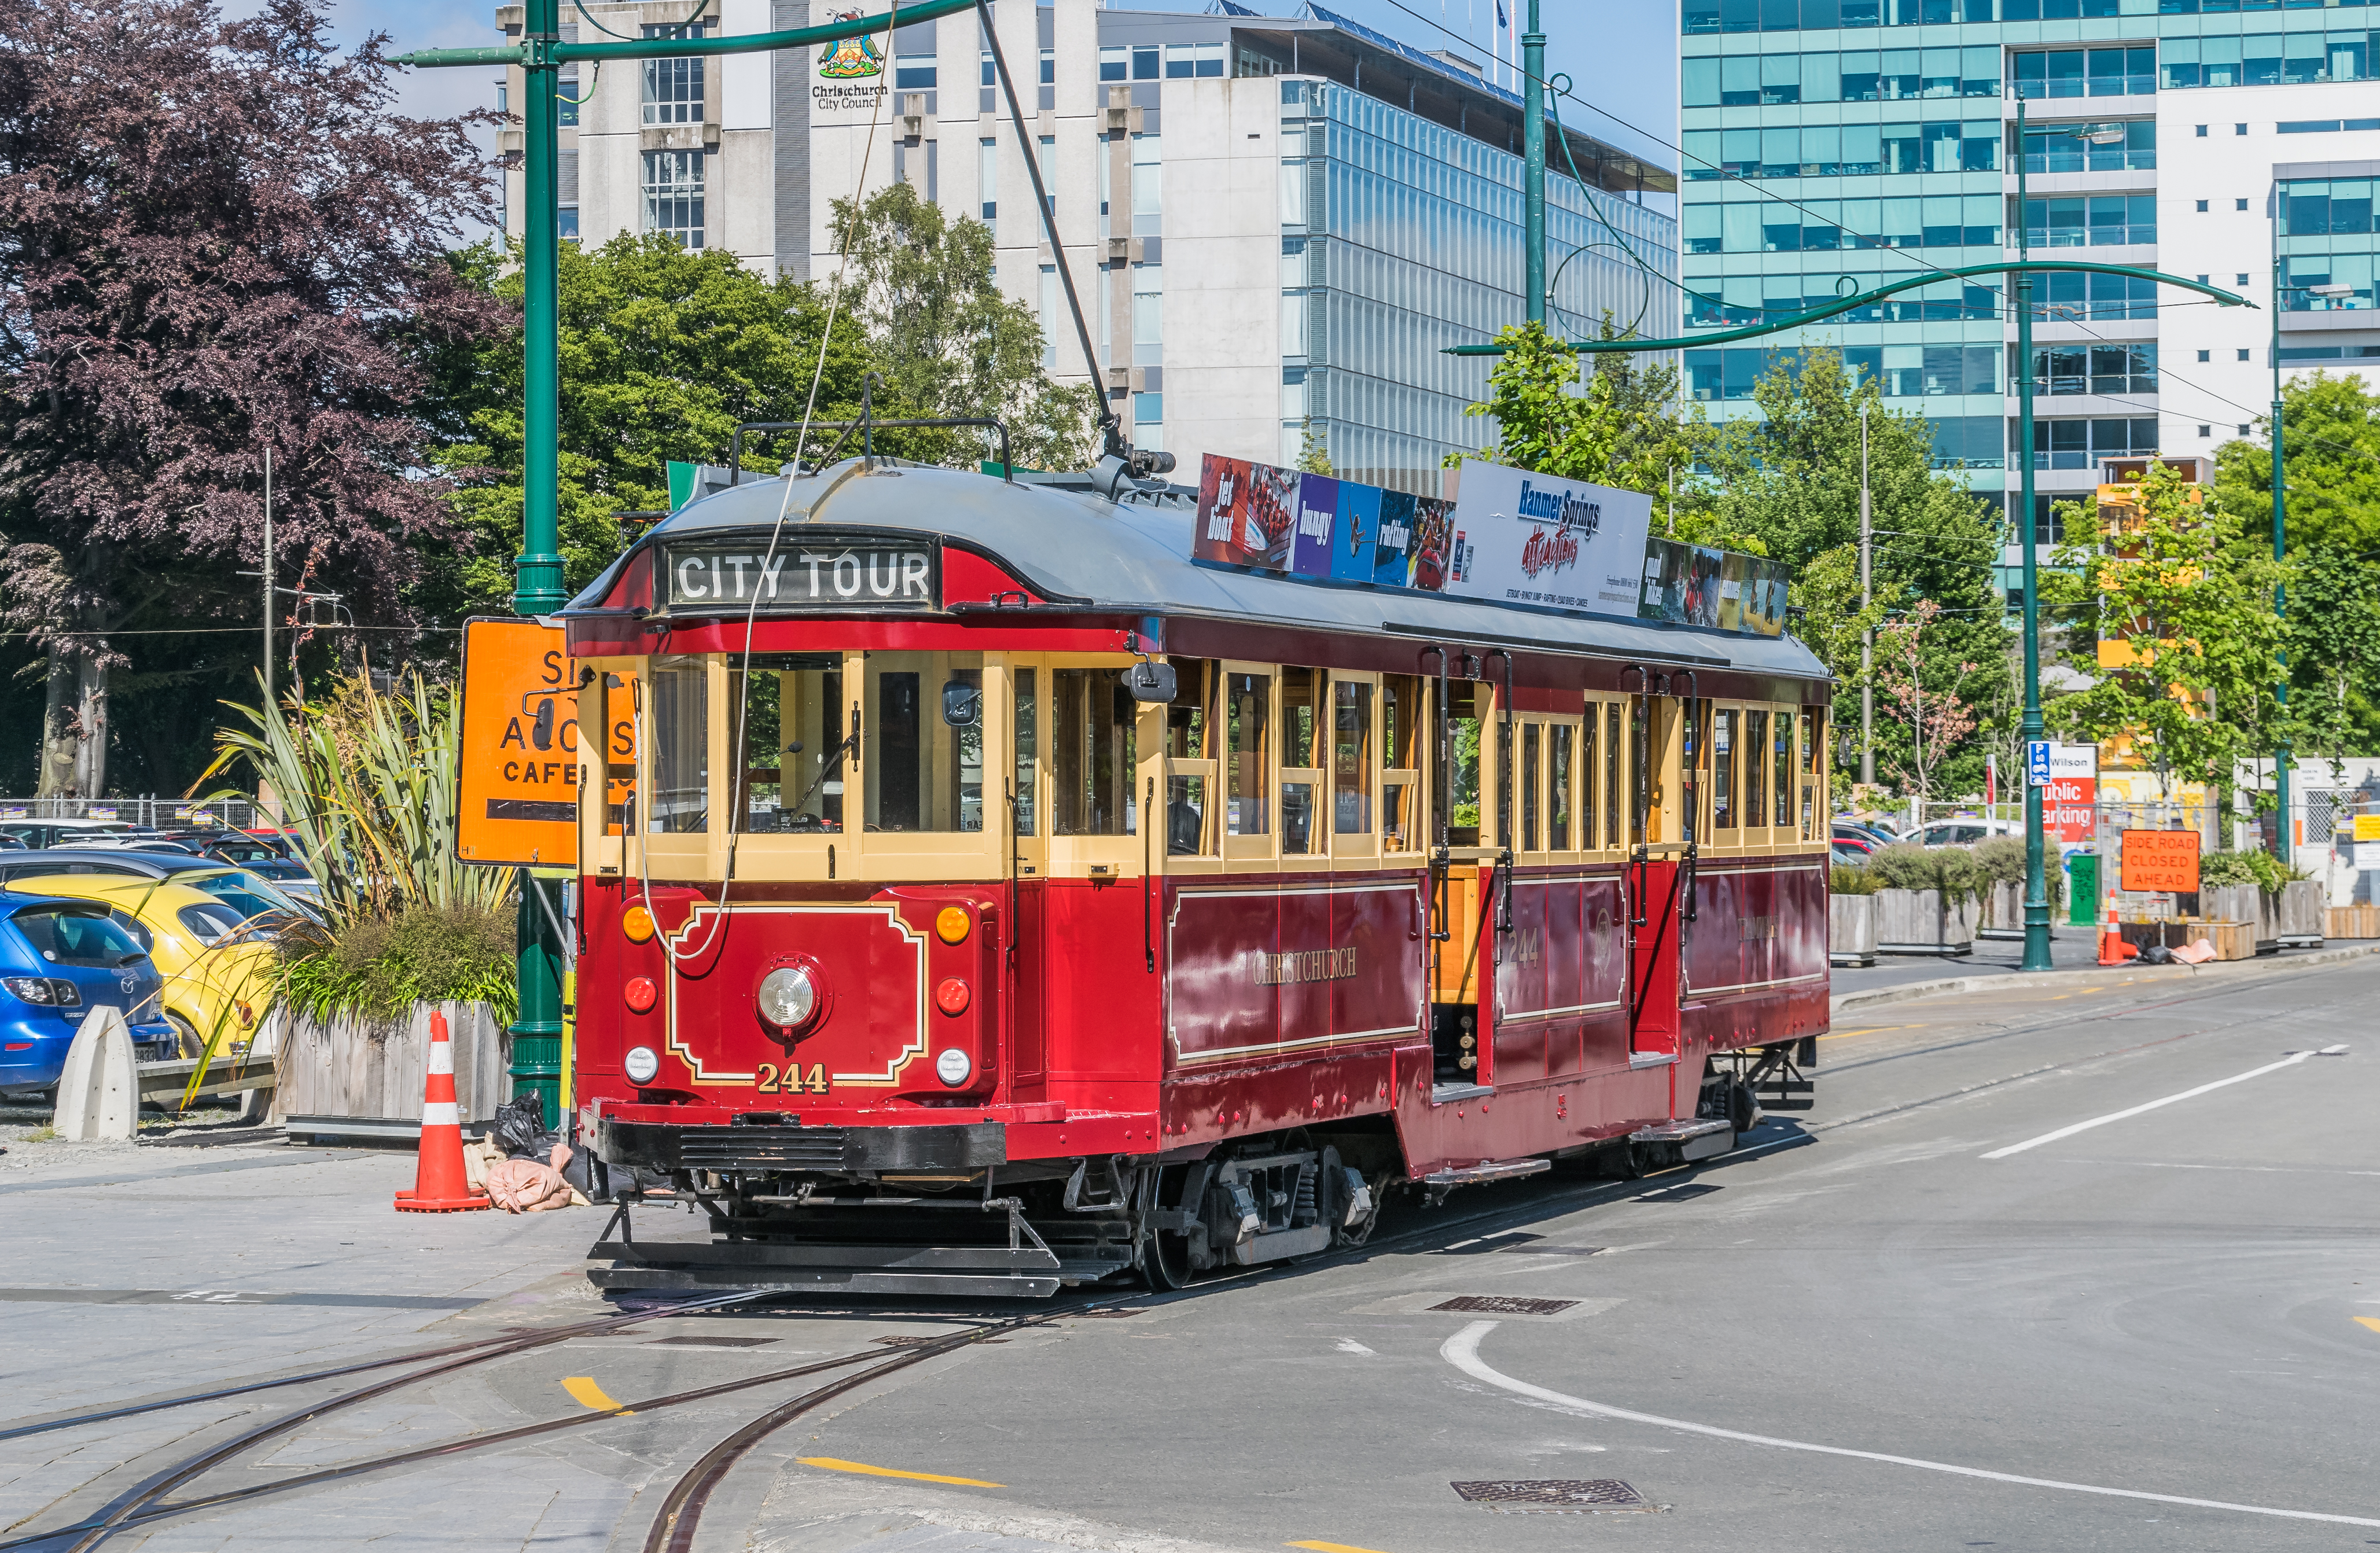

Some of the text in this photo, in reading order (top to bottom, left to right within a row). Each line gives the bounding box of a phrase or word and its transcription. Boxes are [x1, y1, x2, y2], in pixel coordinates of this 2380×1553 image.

[812, 84, 888, 97] Christchurch
[818, 99, 839, 112] City
[1215, 472, 1234, 511] jet
[1518, 480, 1600, 536] Hanmer Springs
[1208, 507, 1234, 542] boat
[1299, 501, 1332, 546] bungy
[1380, 520, 1409, 555] rafting
[1522, 522, 1578, 576] attractions
[678, 553, 929, 598] CITY TOUR
[1645, 553, 1662, 583] quad
[1645, 579, 1663, 605] bikes
[2036, 744, 2044, 753] P
[2050, 758, 2087, 766] Wilson
[2042, 782, 2081, 801] ublic
[2042, 807, 2091, 827] arking
[2125, 837, 2195, 849] SIDE ROAD
[2130, 855, 2188, 867] CLOSED
[2133, 873, 2185, 885] AHEAD
[1508, 927, 1538, 970] 244
[1253, 947, 1356, 985] CHRISTCHURCH
[758, 1063, 829, 1095] 244
